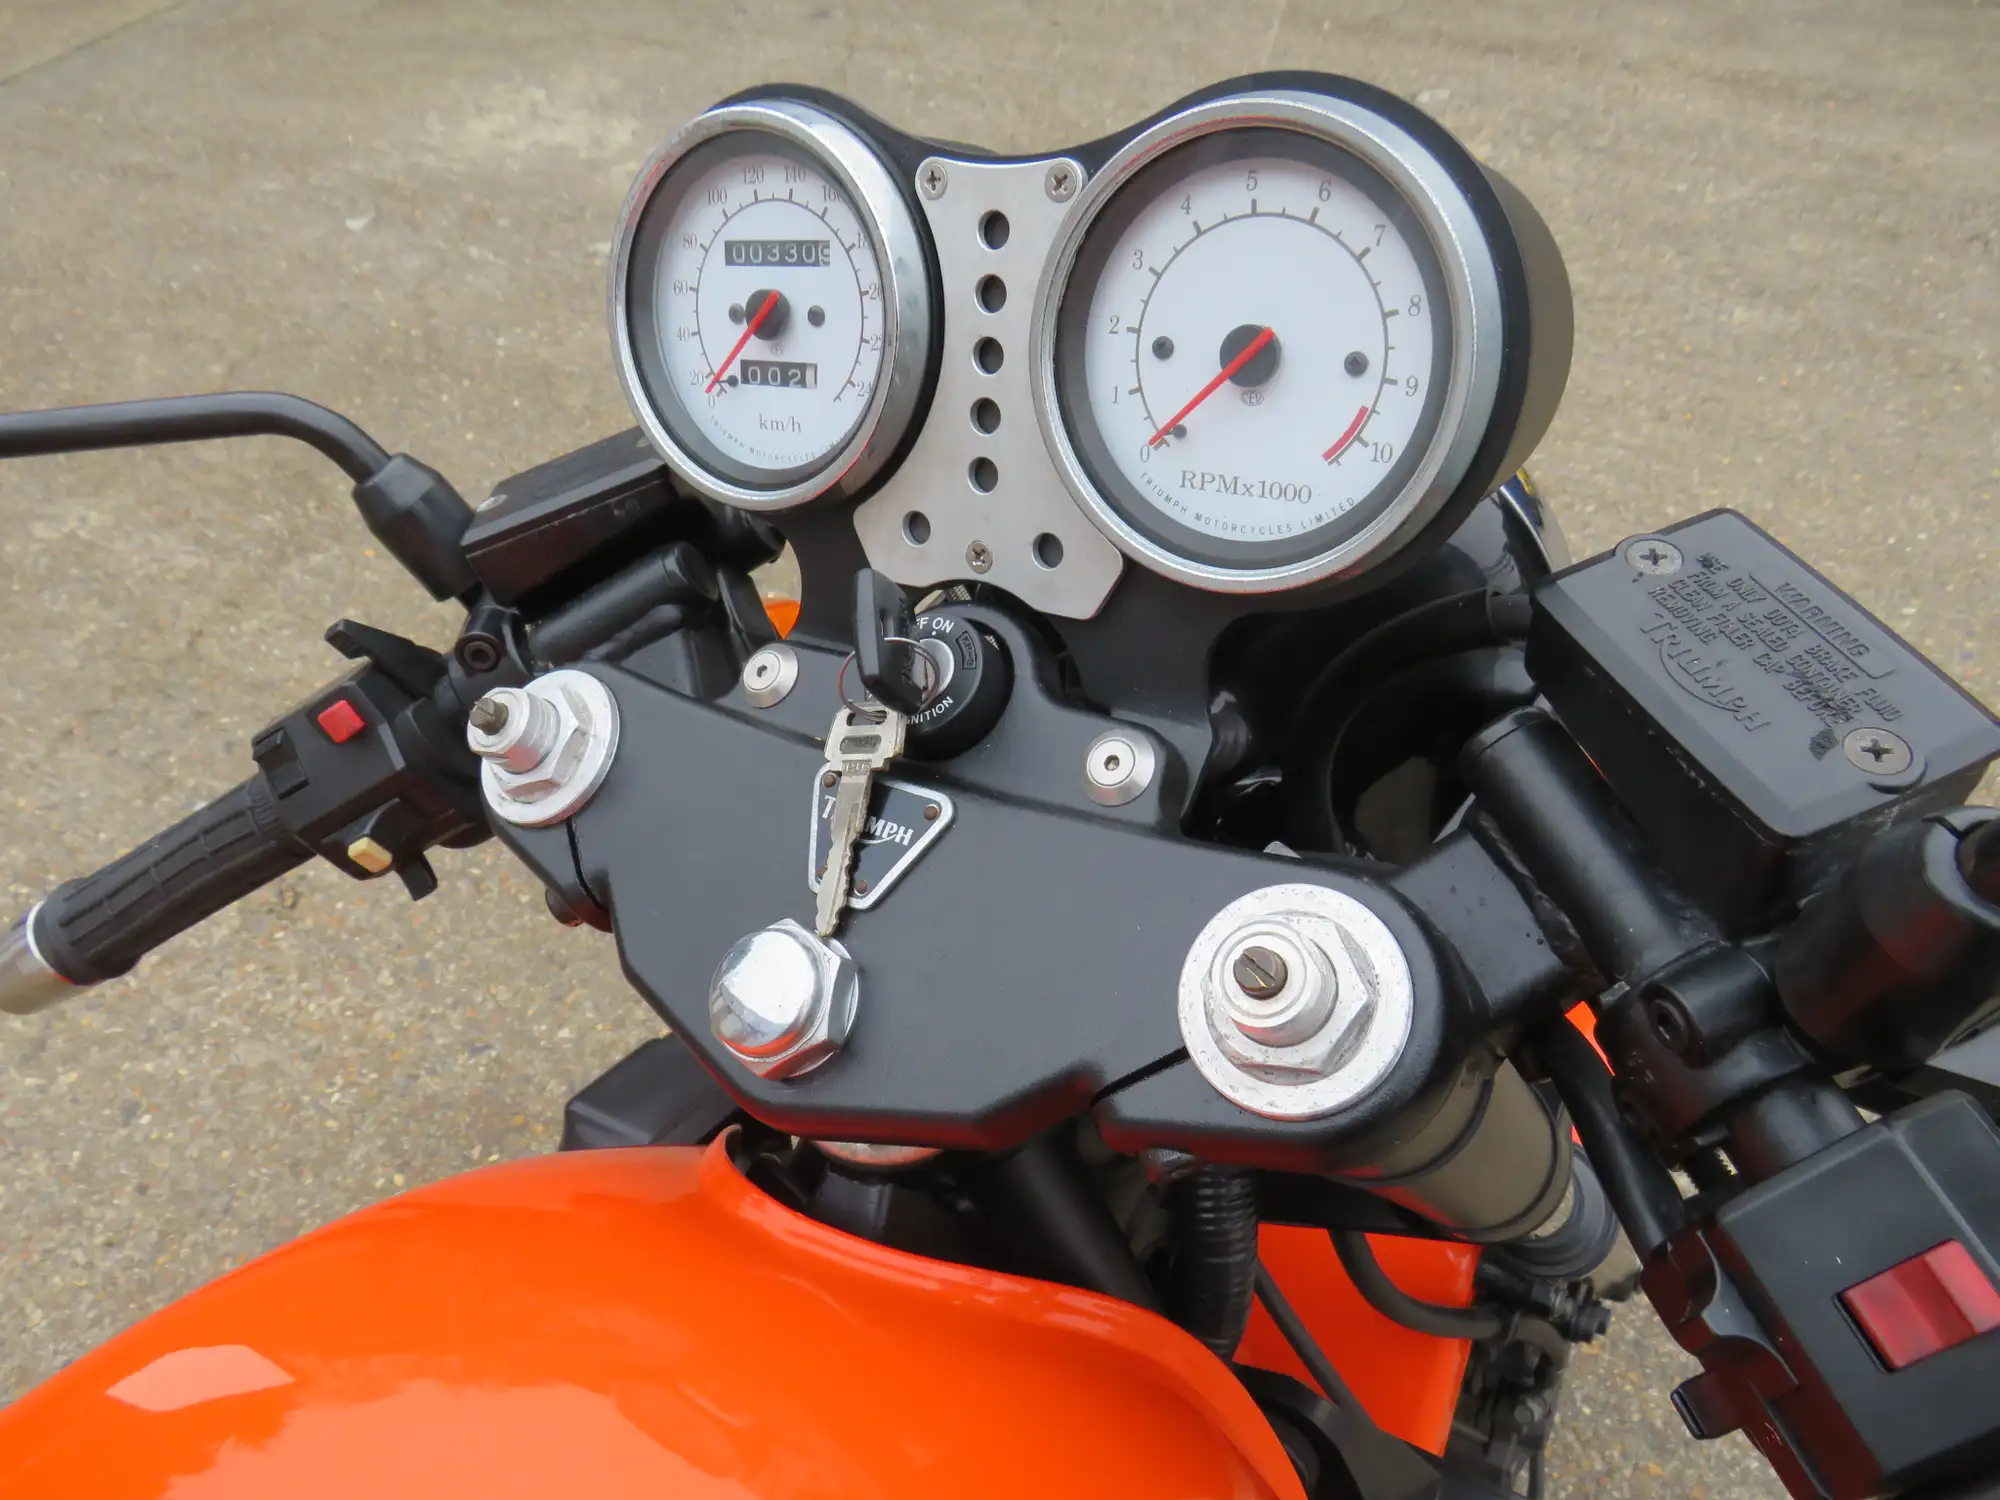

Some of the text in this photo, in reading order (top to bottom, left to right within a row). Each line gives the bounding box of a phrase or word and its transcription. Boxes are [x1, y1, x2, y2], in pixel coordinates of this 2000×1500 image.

[742, 166, 765, 184] 120
[784, 165, 807, 184] 140
[1245, 170, 1259, 192] 5
[707, 187, 728, 205] 100
[1318, 181, 1332, 202] 6
[1180, 194, 1192, 216] 4
[682, 232, 698, 249] 80
[1373, 225, 1387, 247] 7
[1132, 249, 1144, 270] 3
[673, 280, 688, 296] 60
[1407, 294, 1422, 317] 8
[676, 327, 691, 342] 40
[1109, 316, 1121, 336] 2
[689, 370, 704, 386] 20
[1404, 376, 1420, 398] 9
[708, 395, 716, 410] 0
[1111, 386, 1120, 404] 1
[759, 413, 801, 435] km/h
[1139, 444, 1151, 464] 0
[1370, 441, 1394, 465] 10
[1178, 469, 1312, 504] RPMx1000
[1140, 471, 1356, 535] TRIUMPH MOTORCYCLES LIMITED
[1647, 587, 1719, 646] REMOVING
[1686, 571, 1731, 600] FROM
[1720, 600, 1742, 612] A
[1736, 612, 1792, 653] SEALED
[1773, 580, 1871, 658] WARNING
[932, 616, 955, 634] ON
[1726, 577, 1768, 604] ONLY
[1803, 644, 1860, 683] BRAKE
[1853, 687, 1904, 722] FLUID
[1640, 611, 1772, 732] TRIUMPH
[1752, 652, 1787, 684] CAP
[906, 695, 955, 725] NITION
[821, 794, 914, 846] TMPH
